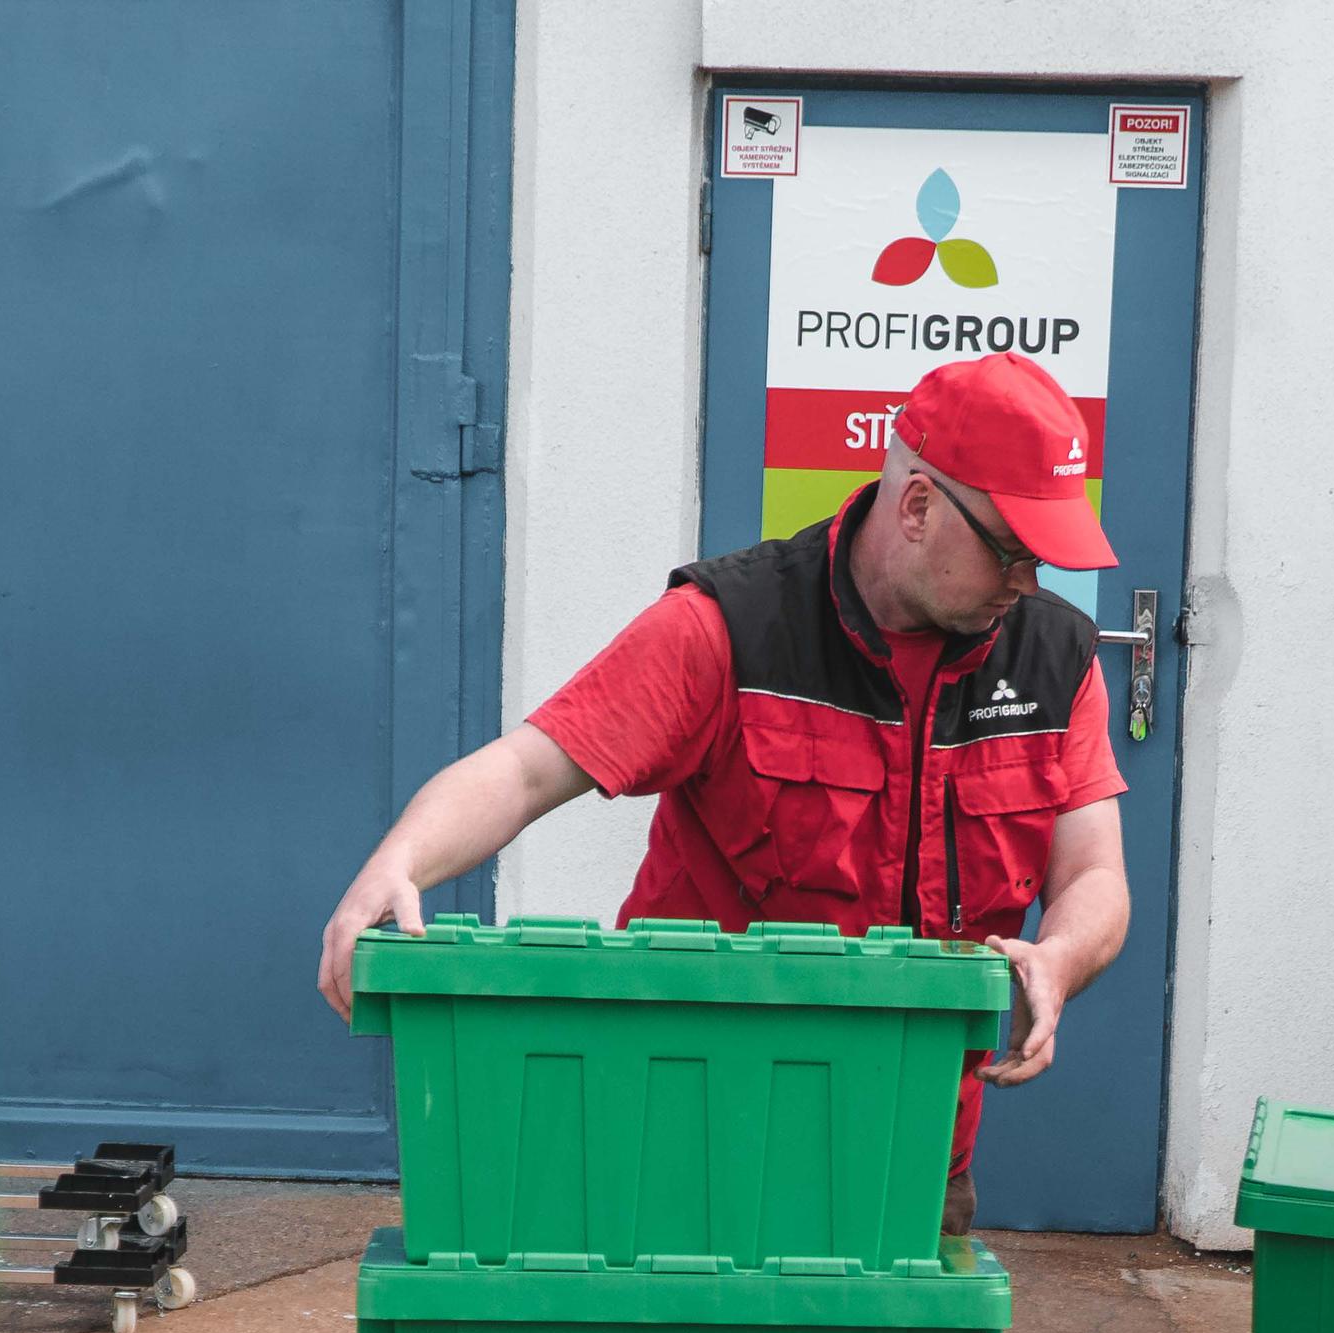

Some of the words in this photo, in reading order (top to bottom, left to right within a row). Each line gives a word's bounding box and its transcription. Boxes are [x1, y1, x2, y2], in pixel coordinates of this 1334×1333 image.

[1126, 118, 1173, 130] POZOR!
[797, 310, 1080, 355] PROFIGROUP
[968, 702, 1038, 722] PROFIGROUP
